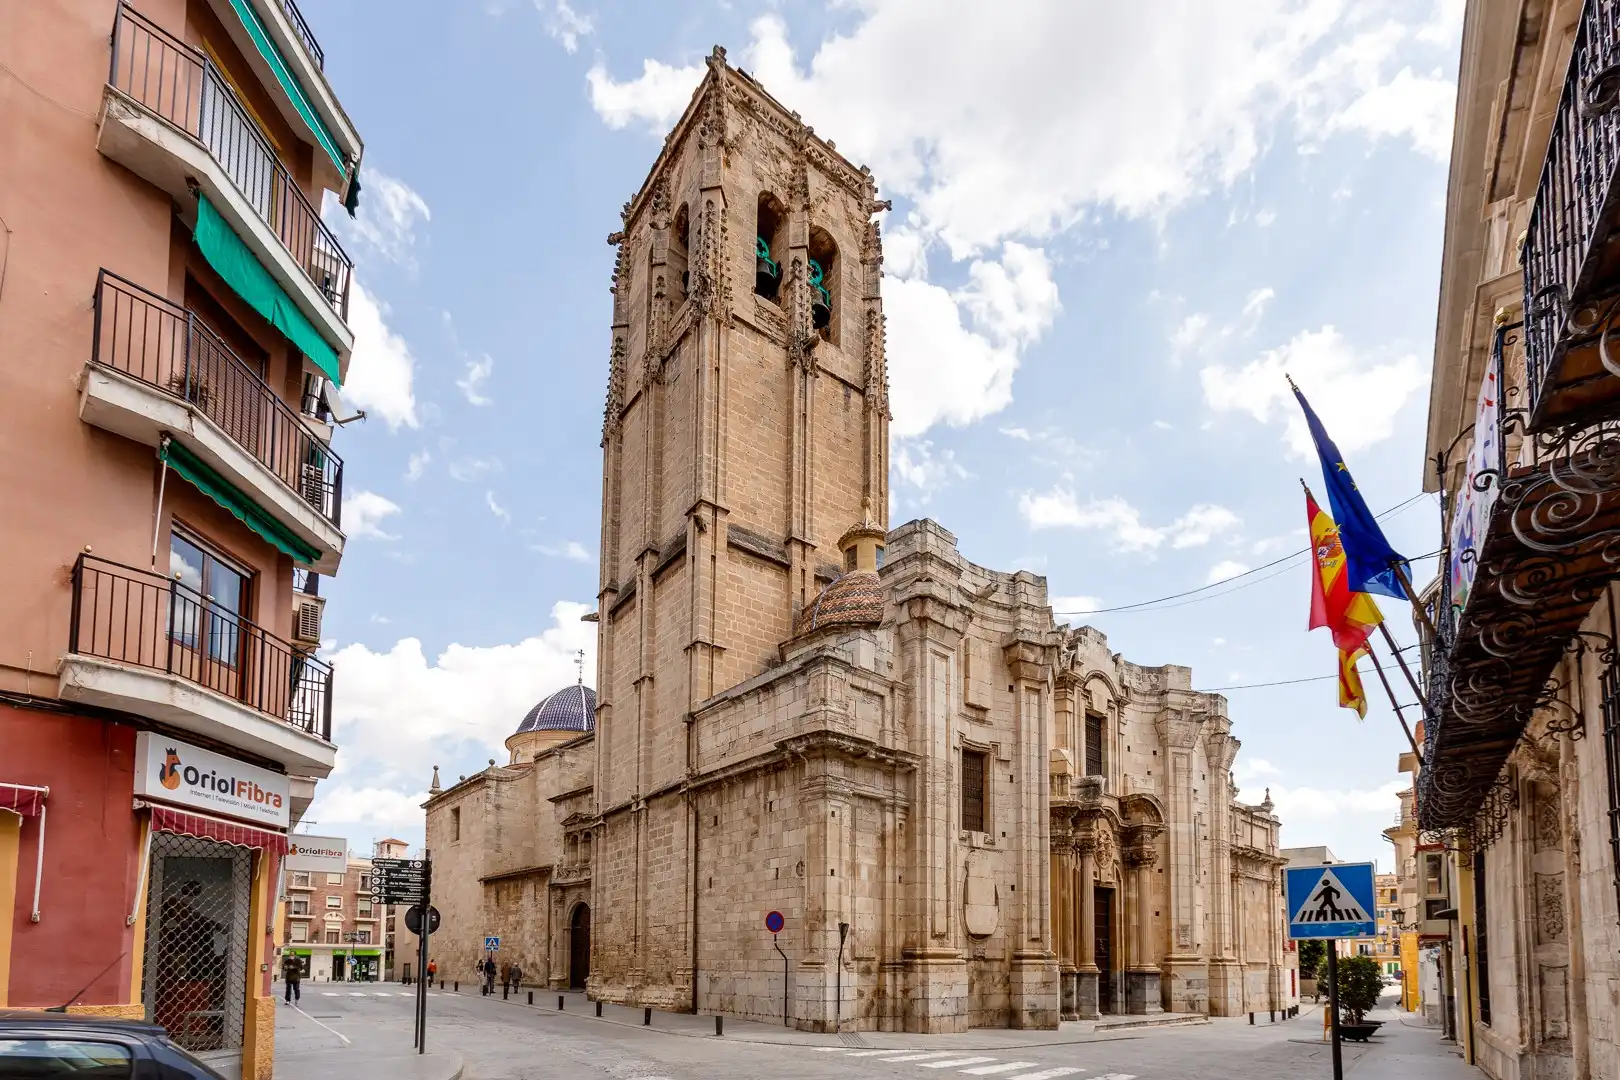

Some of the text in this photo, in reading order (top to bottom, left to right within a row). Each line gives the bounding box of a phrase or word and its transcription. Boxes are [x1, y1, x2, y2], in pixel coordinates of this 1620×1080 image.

[184, 766, 282, 808] OriolFibra
[190, 789, 212, 799] Internet
[298, 847, 343, 857] OriolFibra
